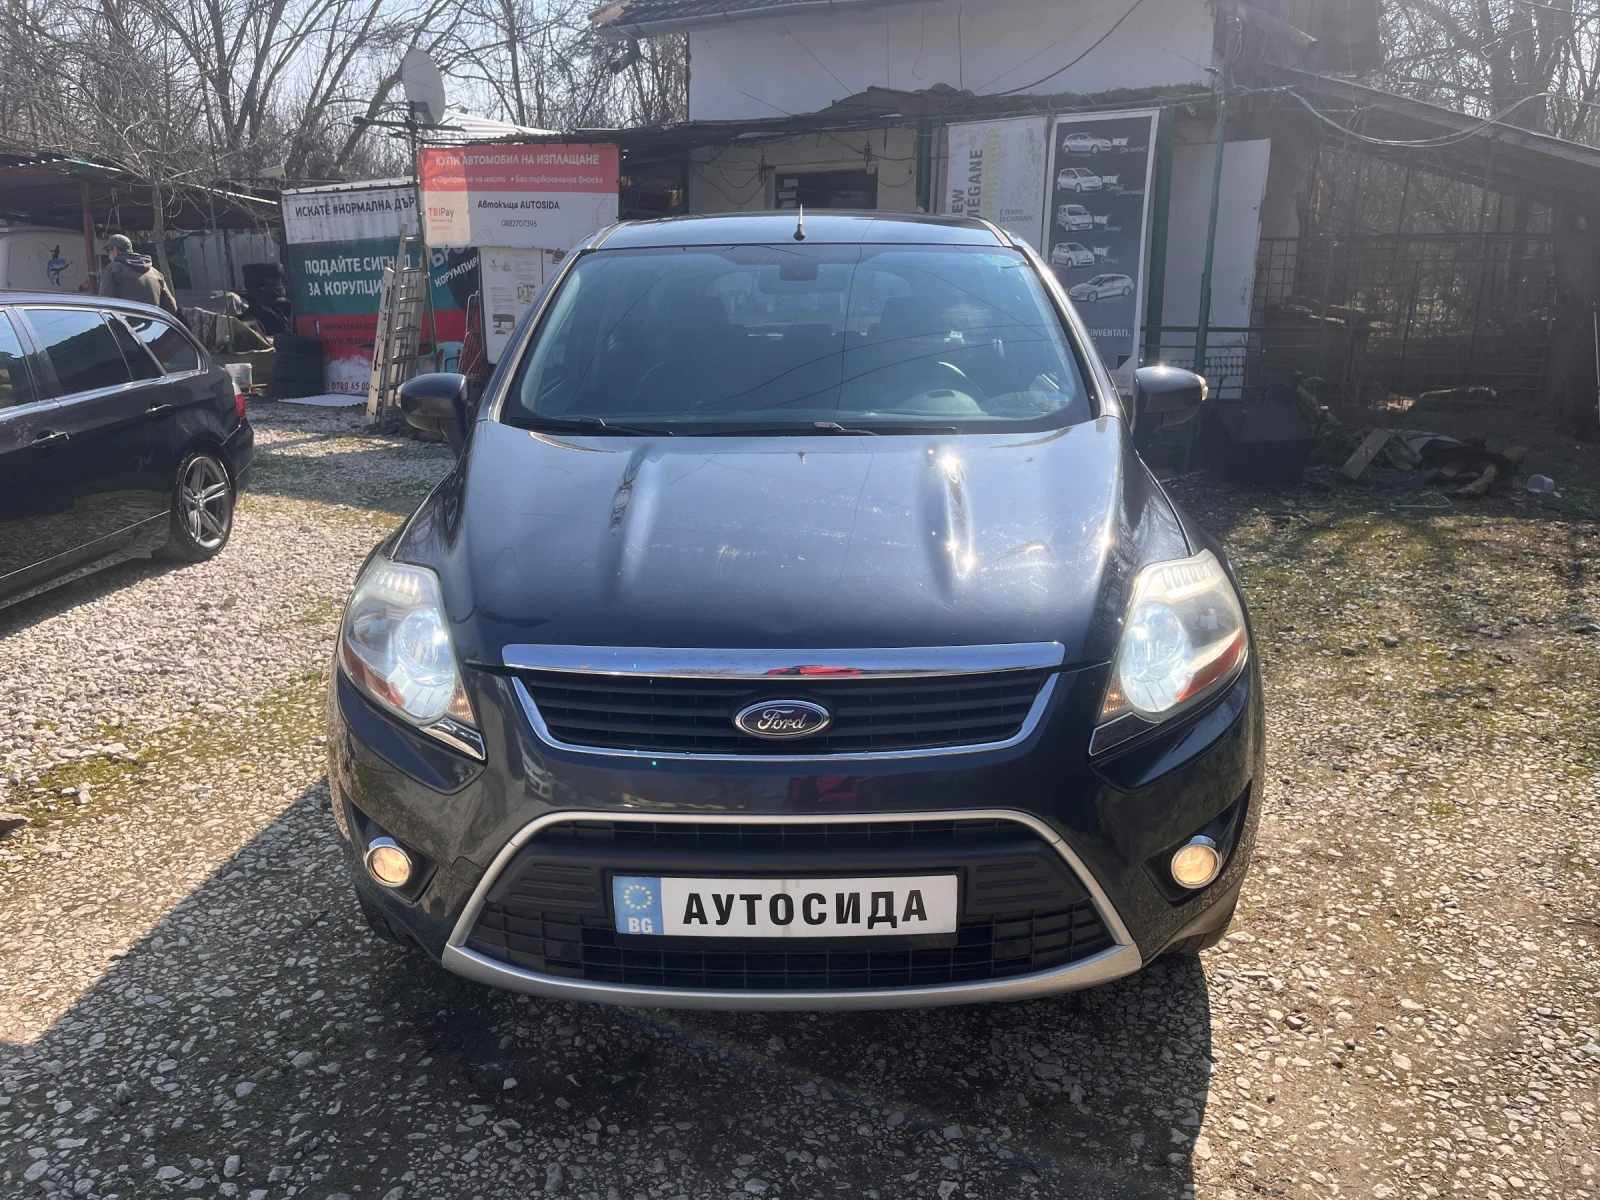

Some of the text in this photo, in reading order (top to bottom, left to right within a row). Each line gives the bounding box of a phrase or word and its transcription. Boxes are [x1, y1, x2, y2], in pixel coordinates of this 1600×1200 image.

[1112, 138, 1128, 146] NEW
[435, 153, 600, 166] КУПИ АВТОМОБИЛ НА ИЗПЛАЩАНЕ
[515, 175, 527, 183] Без
[529, 175, 577, 184] първоначална
[578, 175, 604, 184] вноска
[1102, 175, 1118, 184] NEW
[295, 196, 415, 218] ИСКАТЕ #НОРМАЛНА ДЪР
[477, 200, 560, 210] Автокъща AUTOSIDA
[952, 189, 964, 217] EW
[428, 207, 455, 219] TBIPay
[501, 219, 537, 228] 0882707396
[1093, 215, 1108, 224] NEW
[1093, 247, 1108, 257] NEW
[304, 254, 362, 277] ПОДАЙТЕ
[363, 254, 411, 271] СИГНЛ
[308, 278, 384, 297] ЗА КОРУПЦИ
[757, 709, 806, 731] Ford
[682, 889, 928, 930] АУТОСИДА
[628, 916, 653, 934] BG
